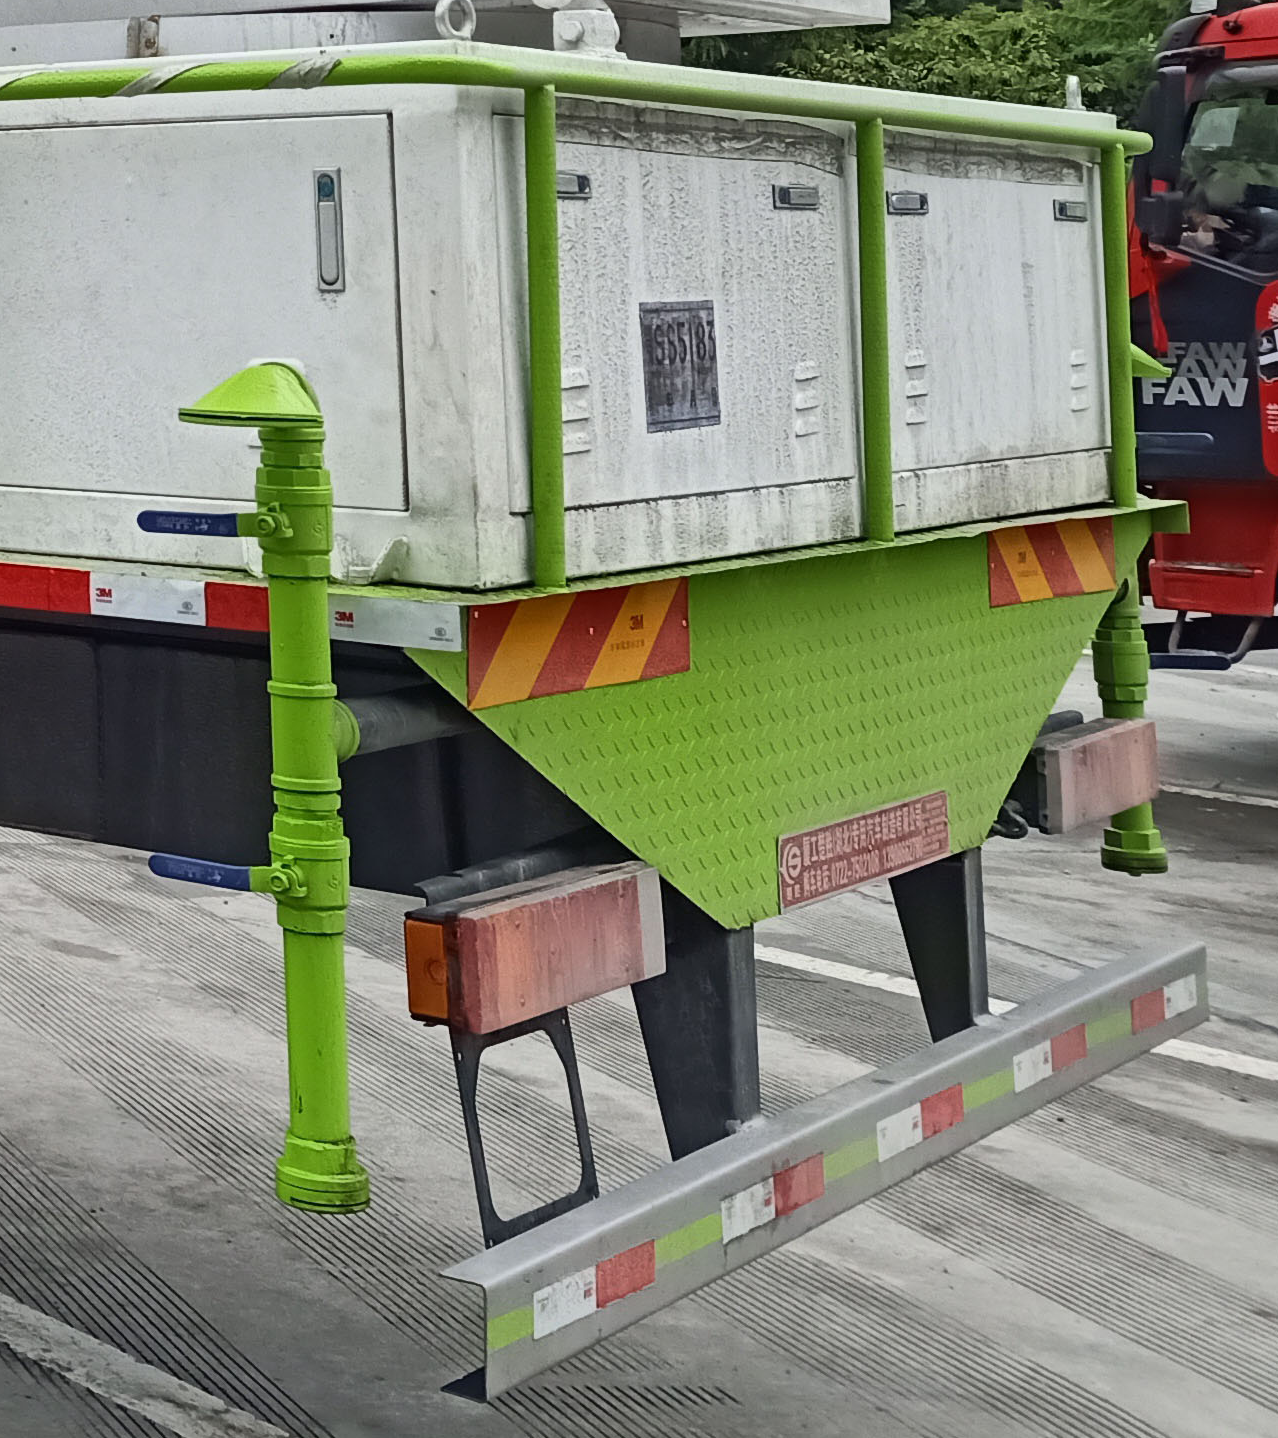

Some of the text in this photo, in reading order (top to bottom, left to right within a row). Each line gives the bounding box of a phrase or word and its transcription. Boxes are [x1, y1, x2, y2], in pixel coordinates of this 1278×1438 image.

[1141, 376, 1249, 407] FAW
[95, 587, 113, 599] 3M
[334, 610, 354, 623] 3M
[628, 613, 645, 631] 3M
